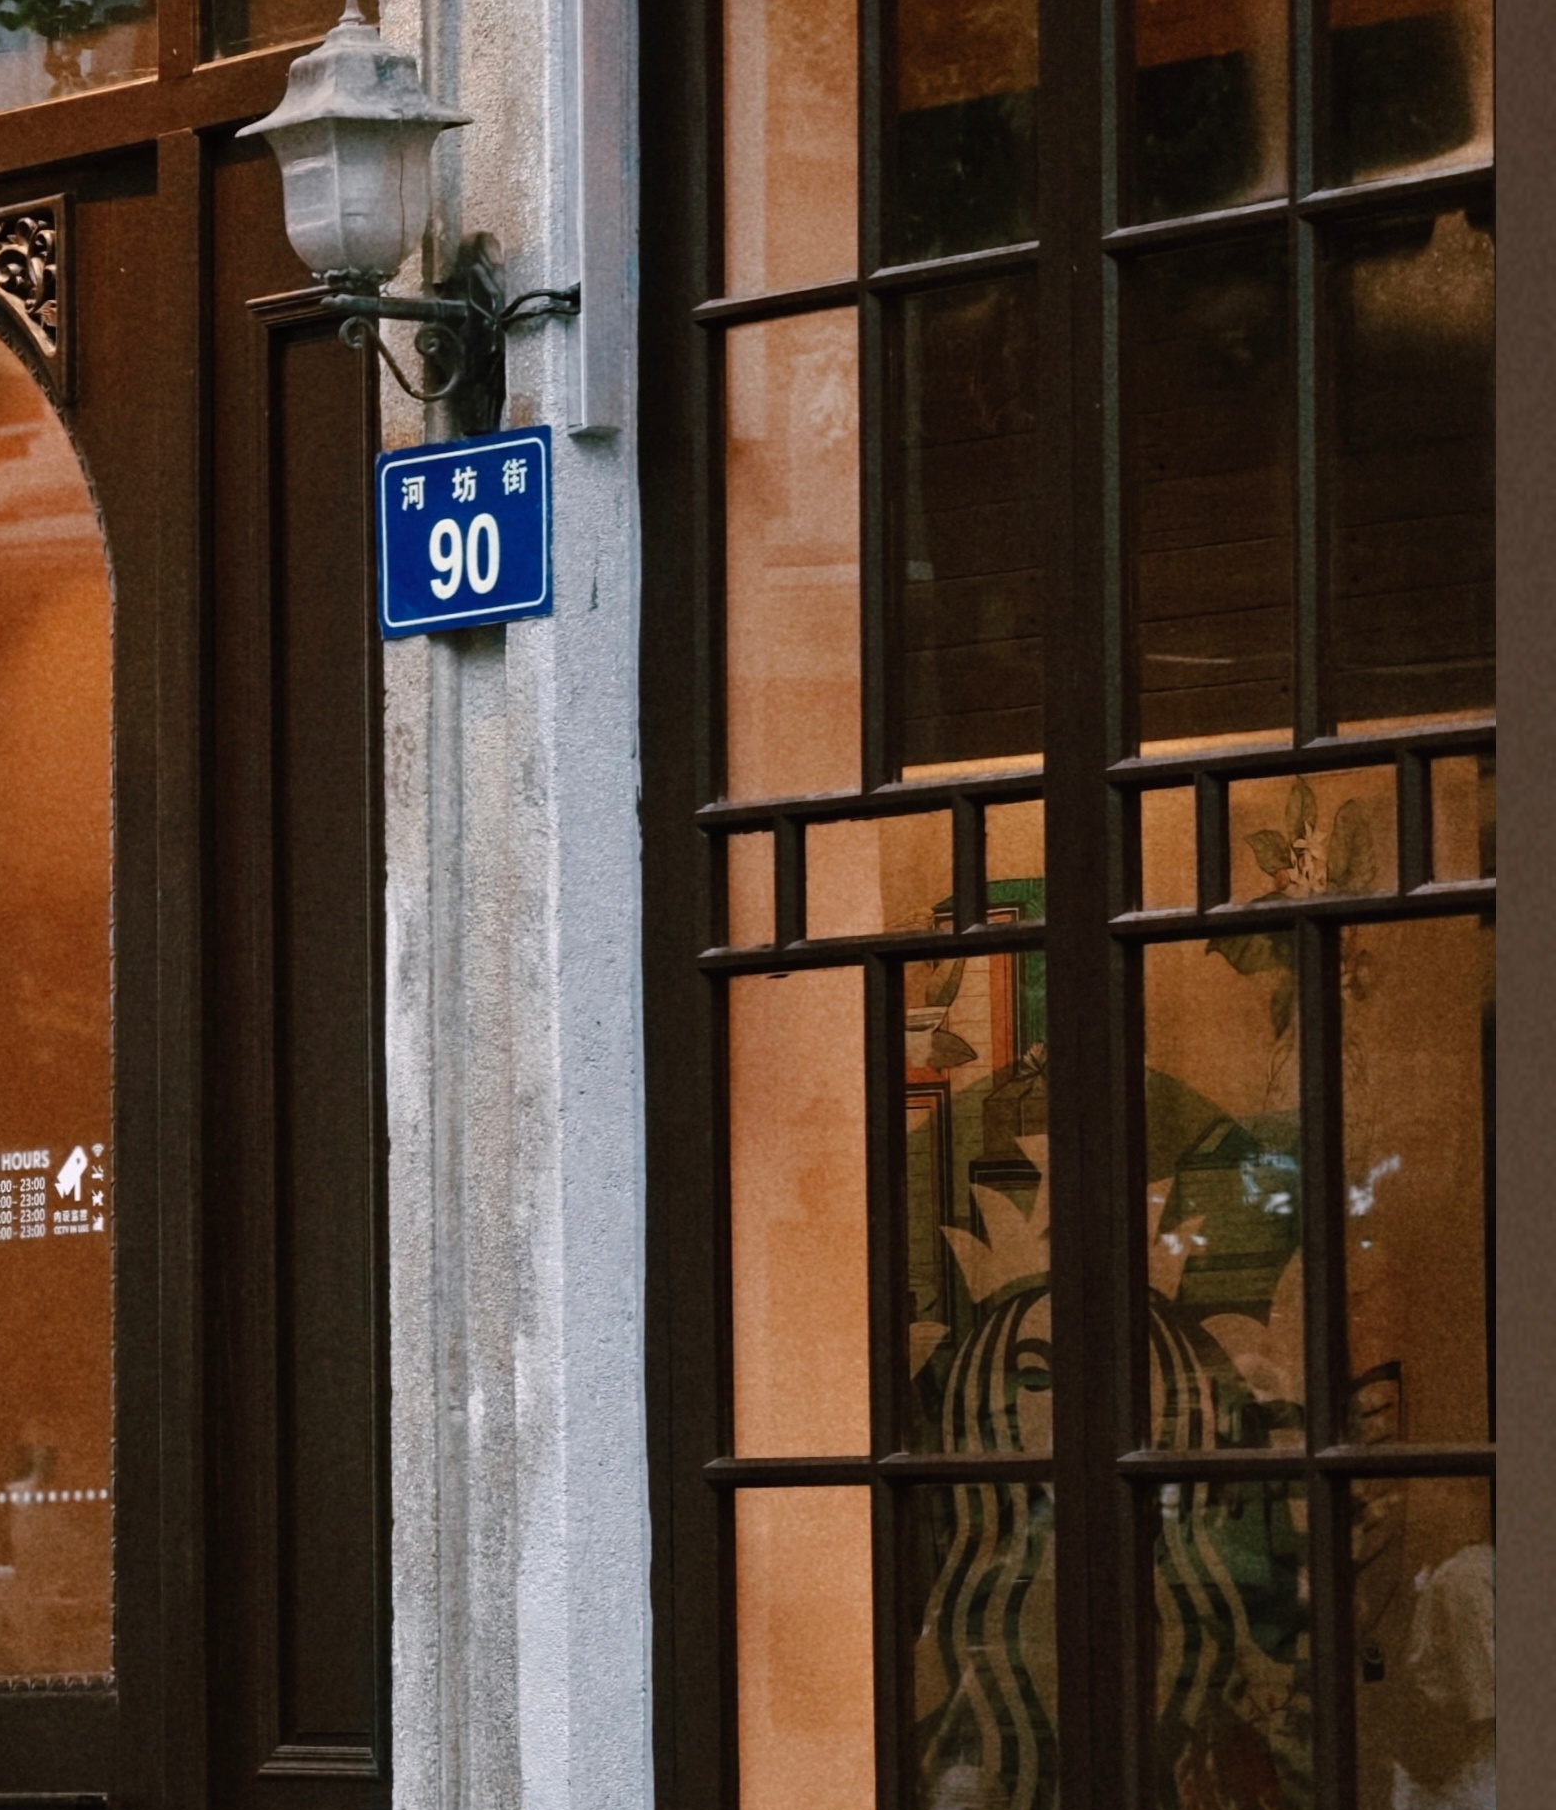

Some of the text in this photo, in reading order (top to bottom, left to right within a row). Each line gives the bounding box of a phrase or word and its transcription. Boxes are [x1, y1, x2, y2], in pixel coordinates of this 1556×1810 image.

[400, 457, 529, 512] 河坊街
[428, 512, 501, 601] 90
[1, 1149, 51, 1172] HOURS
